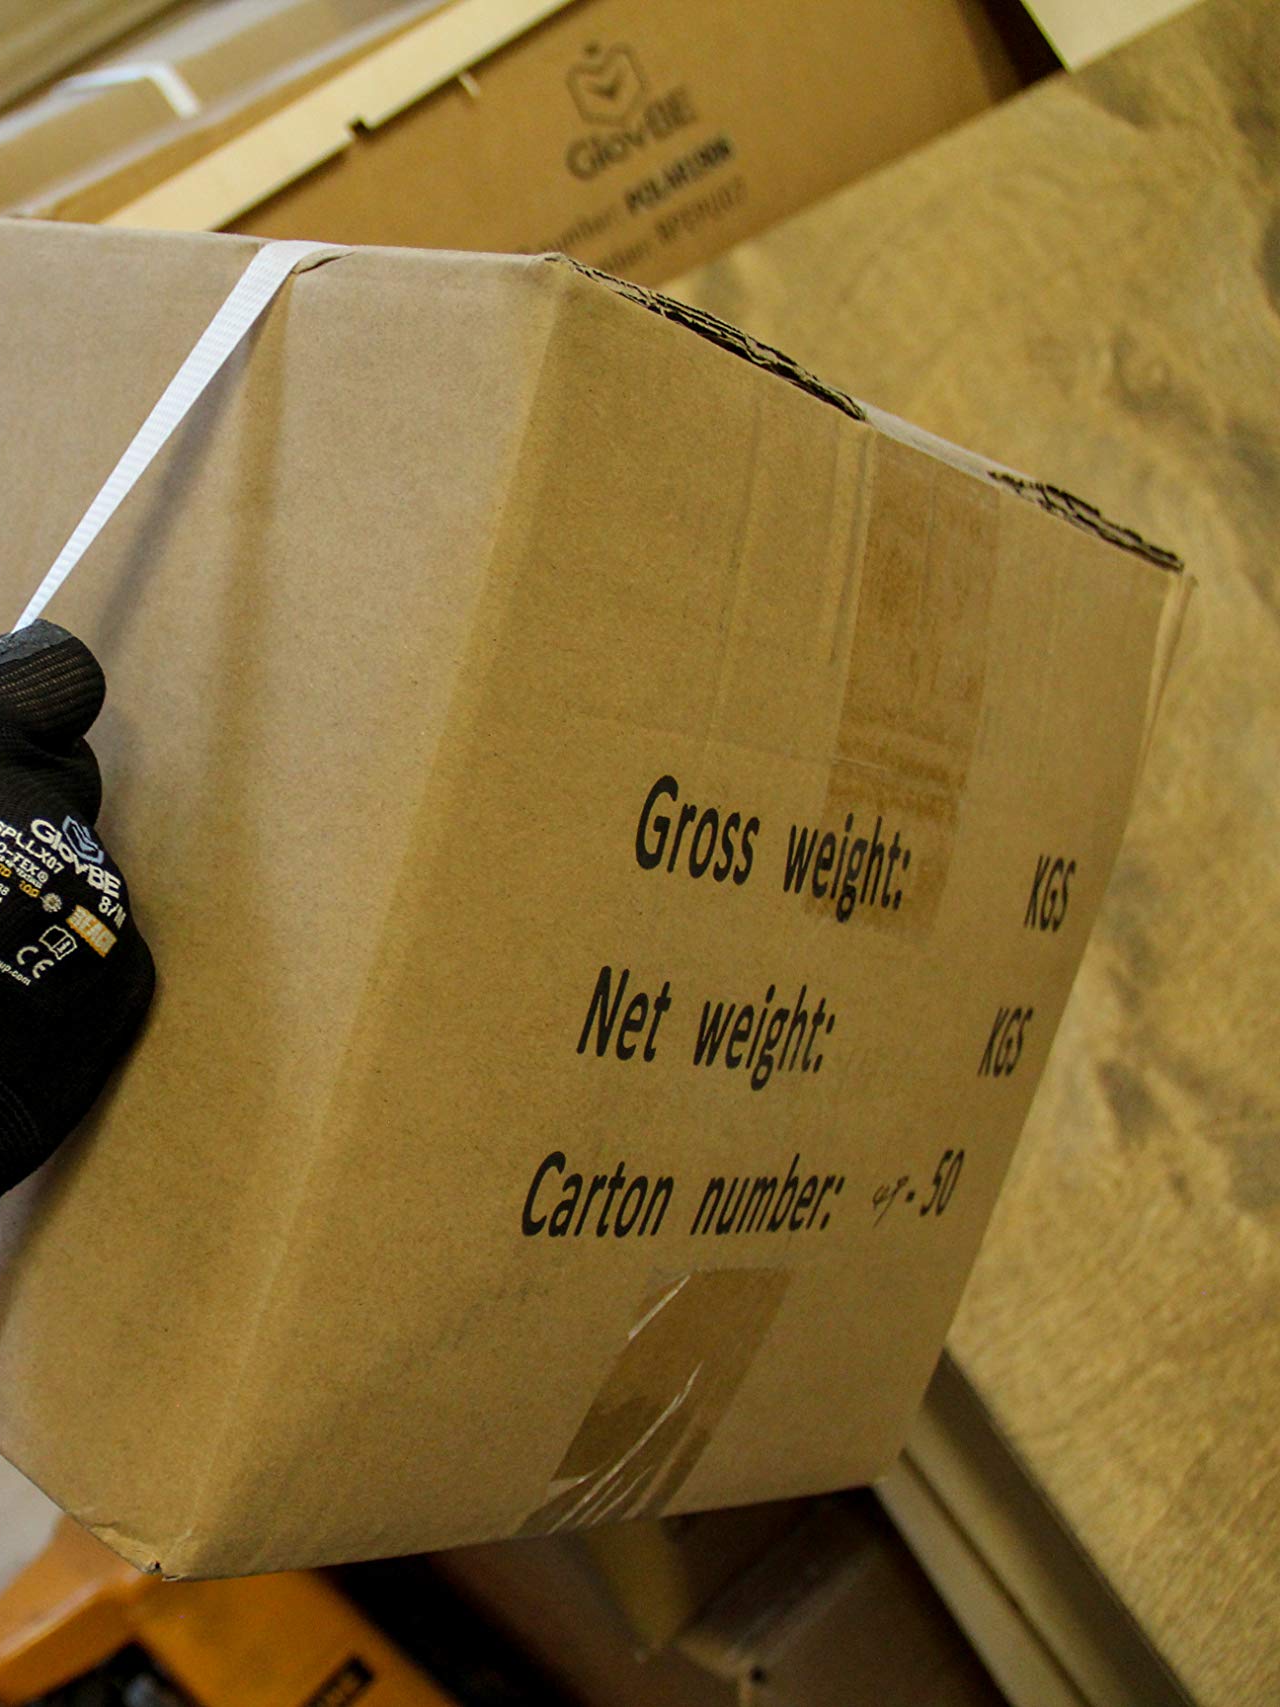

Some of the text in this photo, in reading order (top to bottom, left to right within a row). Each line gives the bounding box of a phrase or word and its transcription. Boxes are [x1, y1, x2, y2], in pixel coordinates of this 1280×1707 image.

[30, 818, 121, 899] GlovBE
[635, 775, 1075, 932] Gross weight: KGS
[577, 965, 1033, 1091] Net weight: KGS
[521, 1151, 674, 1238] Carton
[690, 1153, 845, 1235] number:
